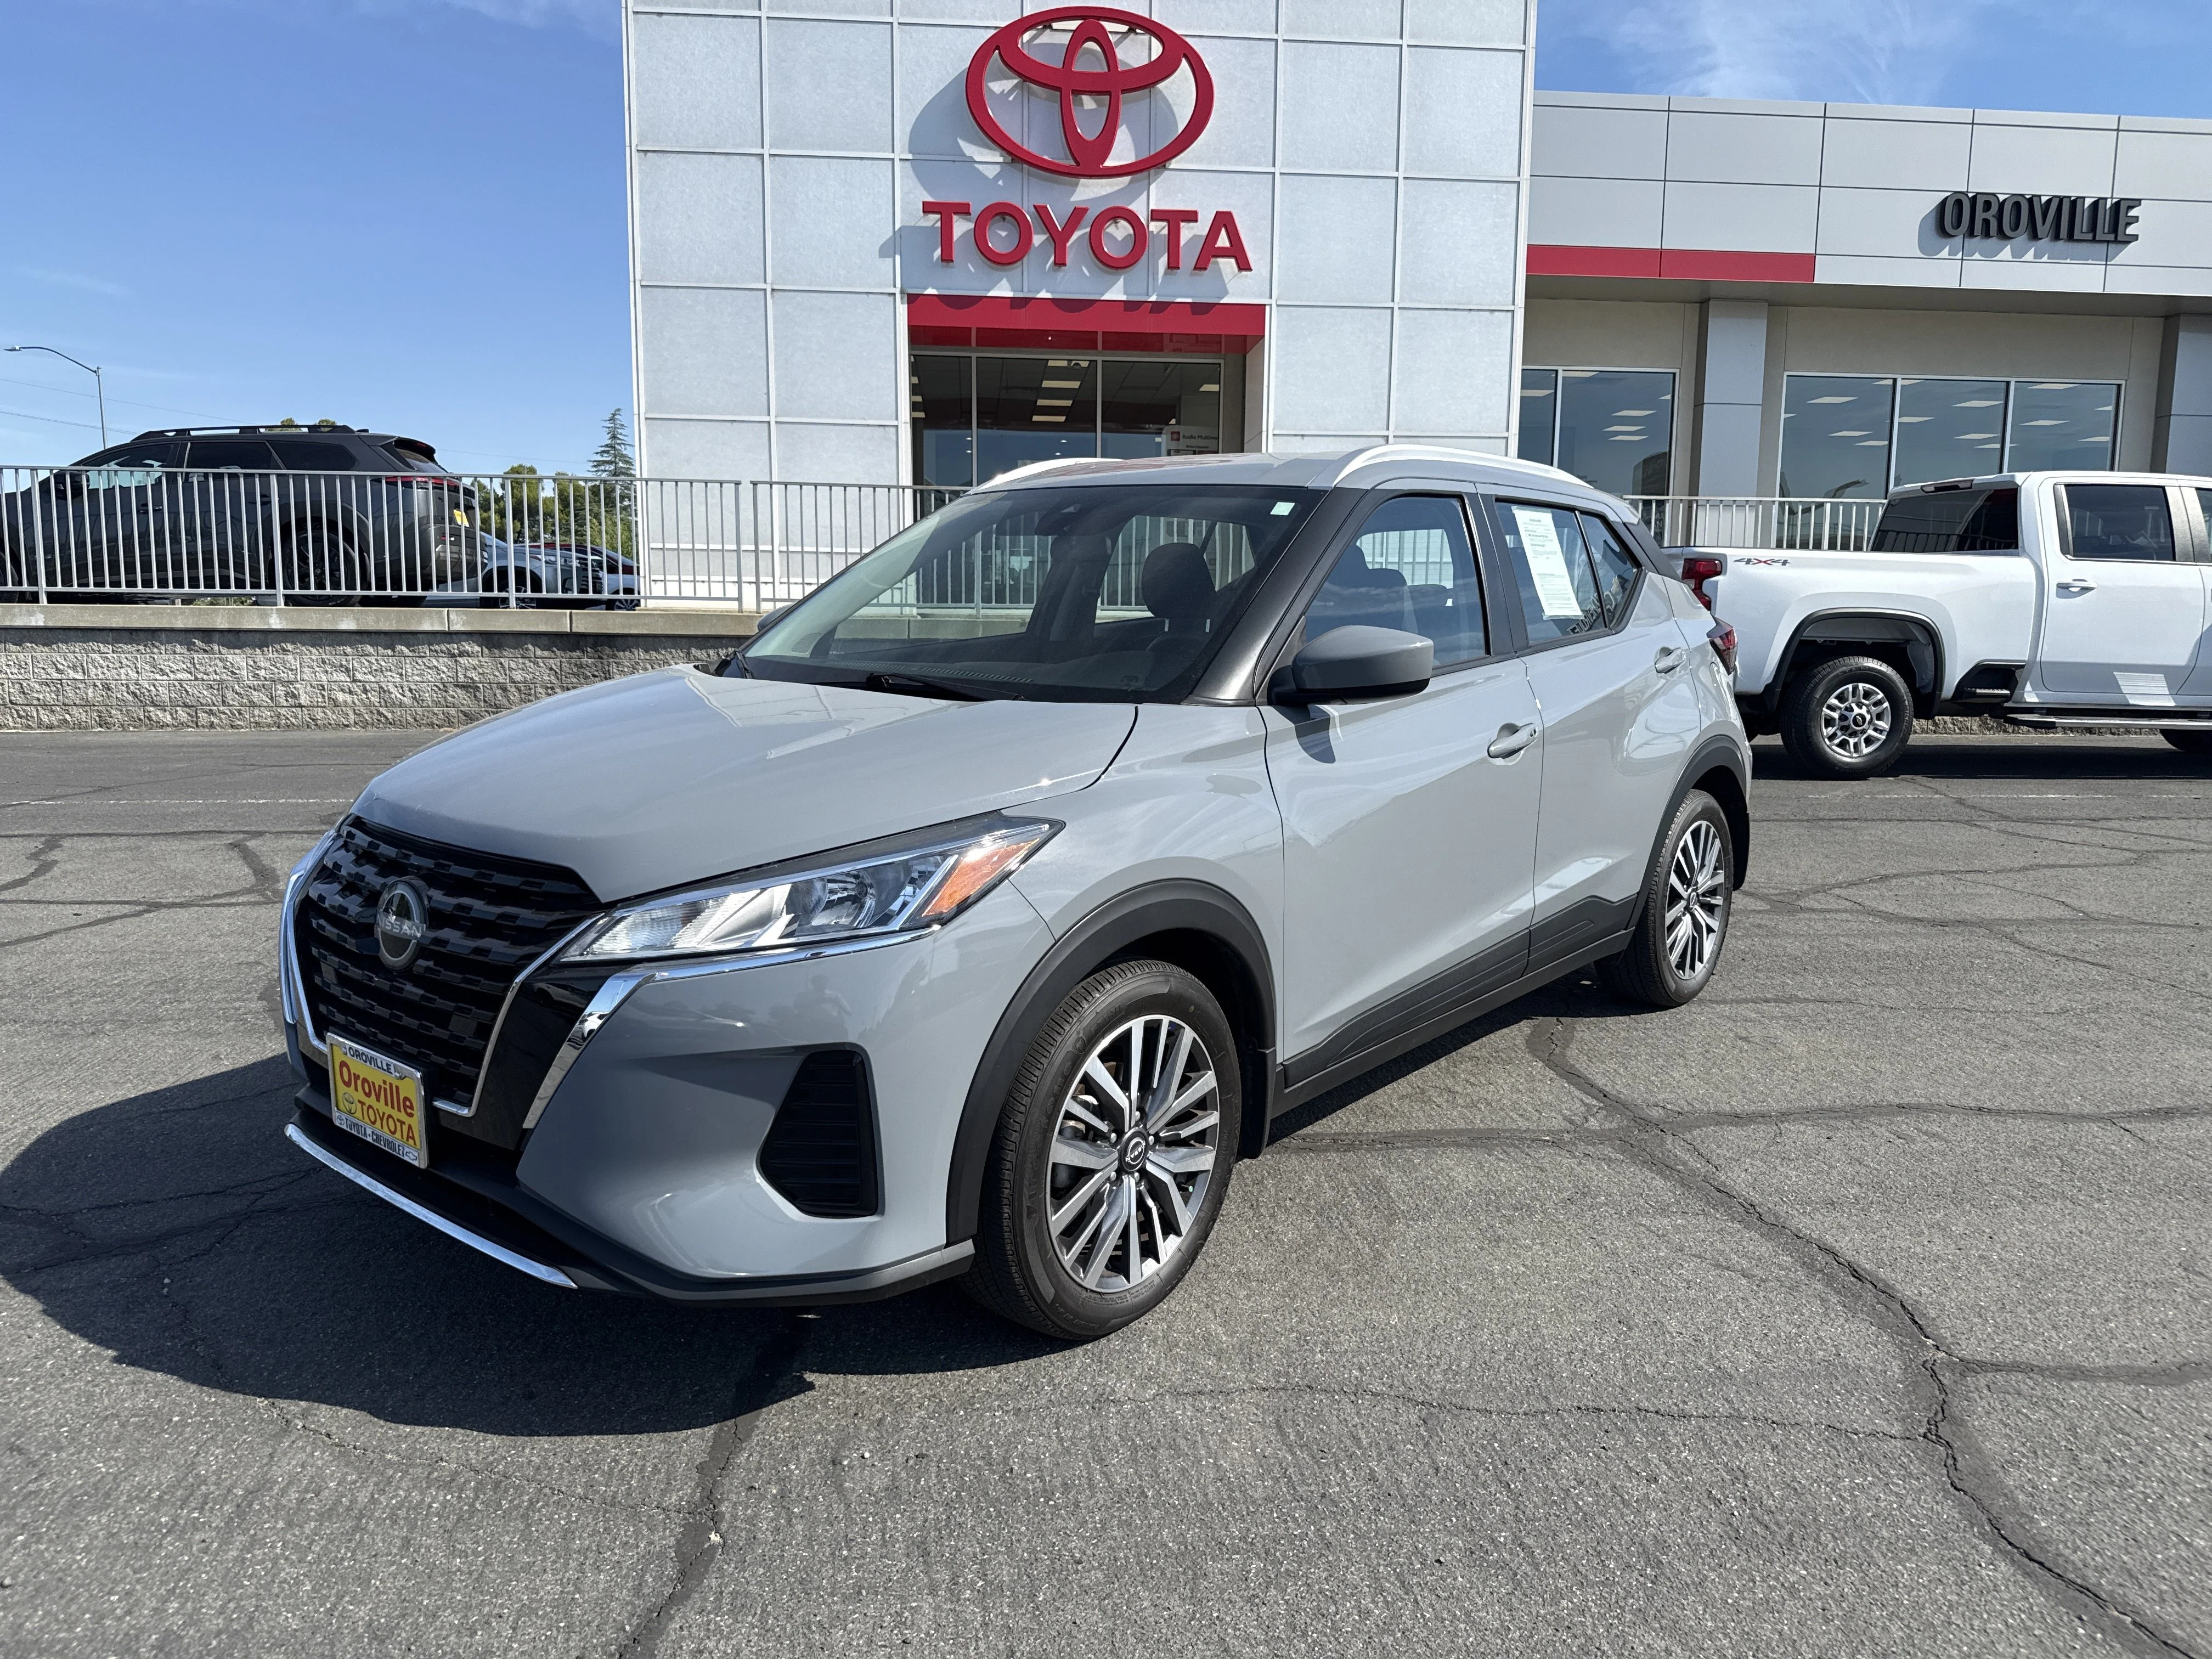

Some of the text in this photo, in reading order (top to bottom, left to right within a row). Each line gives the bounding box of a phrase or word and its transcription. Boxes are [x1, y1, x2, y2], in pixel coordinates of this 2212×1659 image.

[922, 201, 1253, 272] TOYOTA
[1941, 192, 2141, 242] OROVILLE
[377, 913, 422, 938] NISSAN
[348, 1046, 393, 1074] OROVILLE
[339, 1060, 415, 1118] Oroville
[345, 1117, 406, 1158] TOYOTA CHEVROLET
[358, 1099, 417, 1146] TOYOTA
